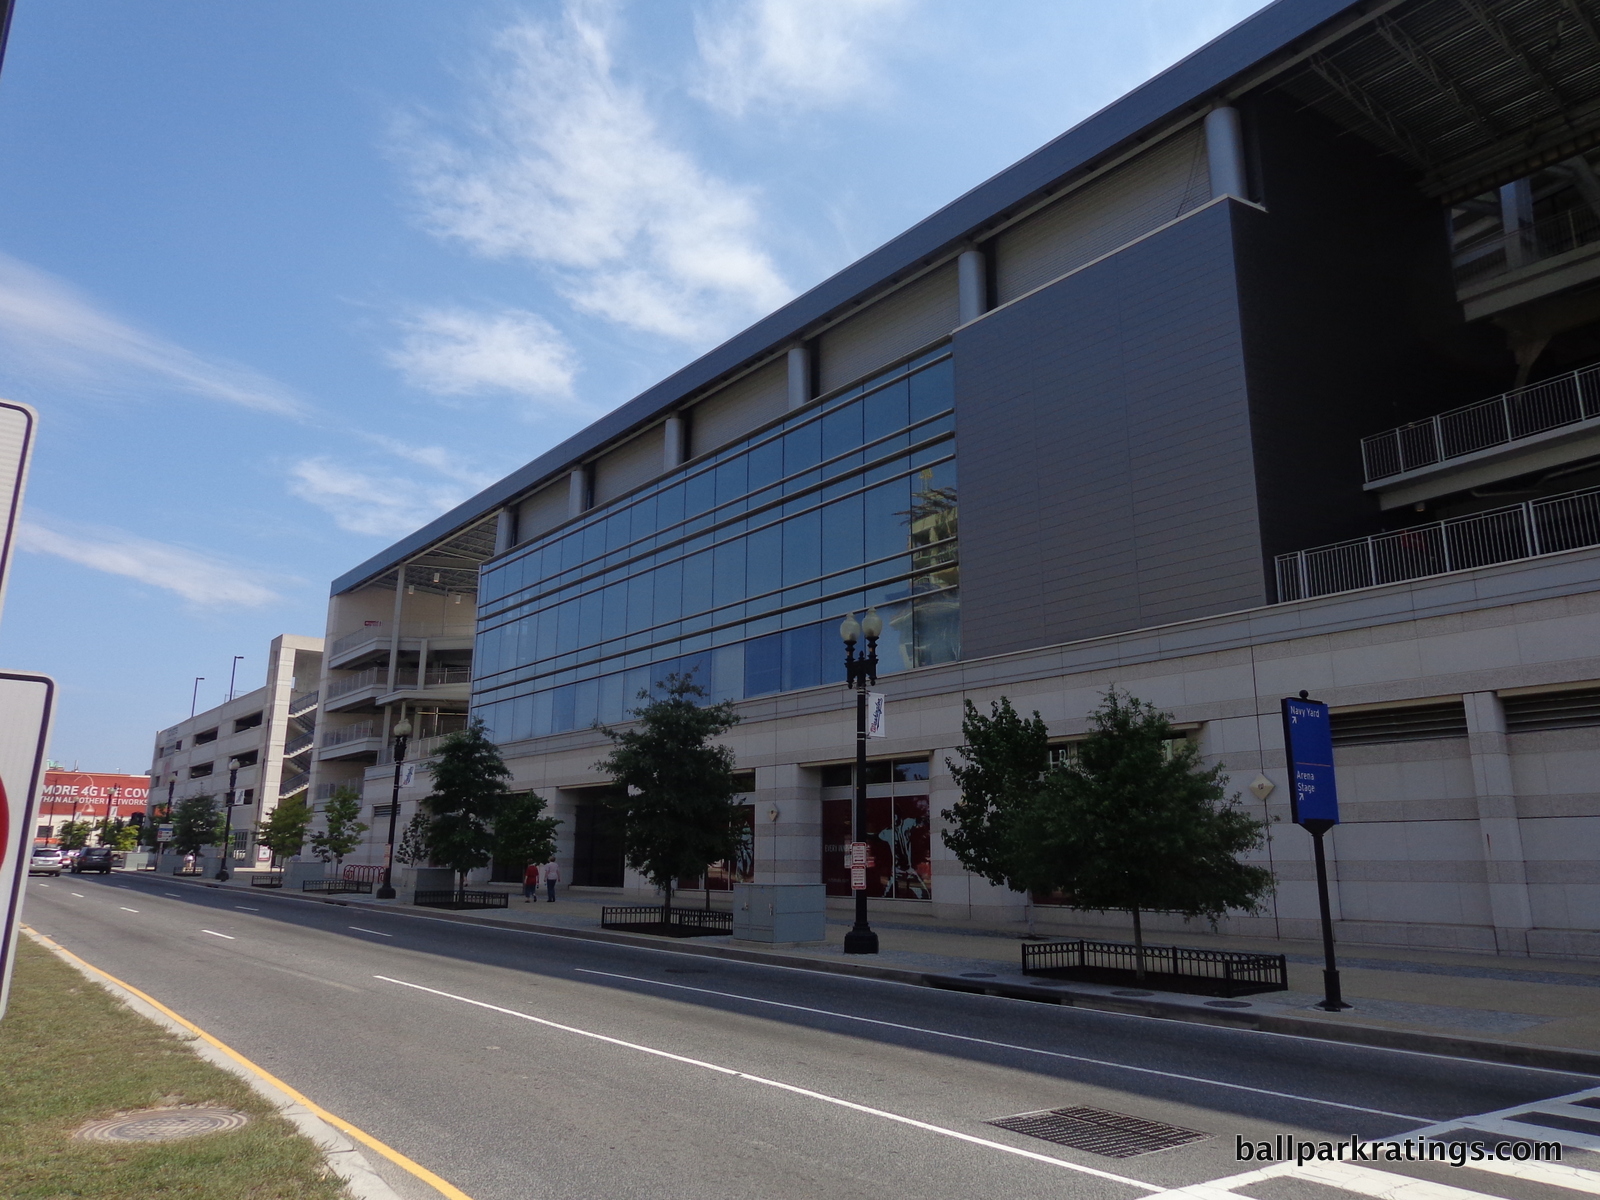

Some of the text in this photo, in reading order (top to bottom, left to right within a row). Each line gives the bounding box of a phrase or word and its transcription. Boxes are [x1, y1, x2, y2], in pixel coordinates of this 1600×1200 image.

[1290, 705, 1320, 718] Navy Yard
[1296, 770, 1315, 780] Arena
[42, 784, 79, 796] MORE
[81, 785, 99, 797] 4G
[1297, 782, 1315, 794] Stage
[78, 797, 104, 805] OTHER
